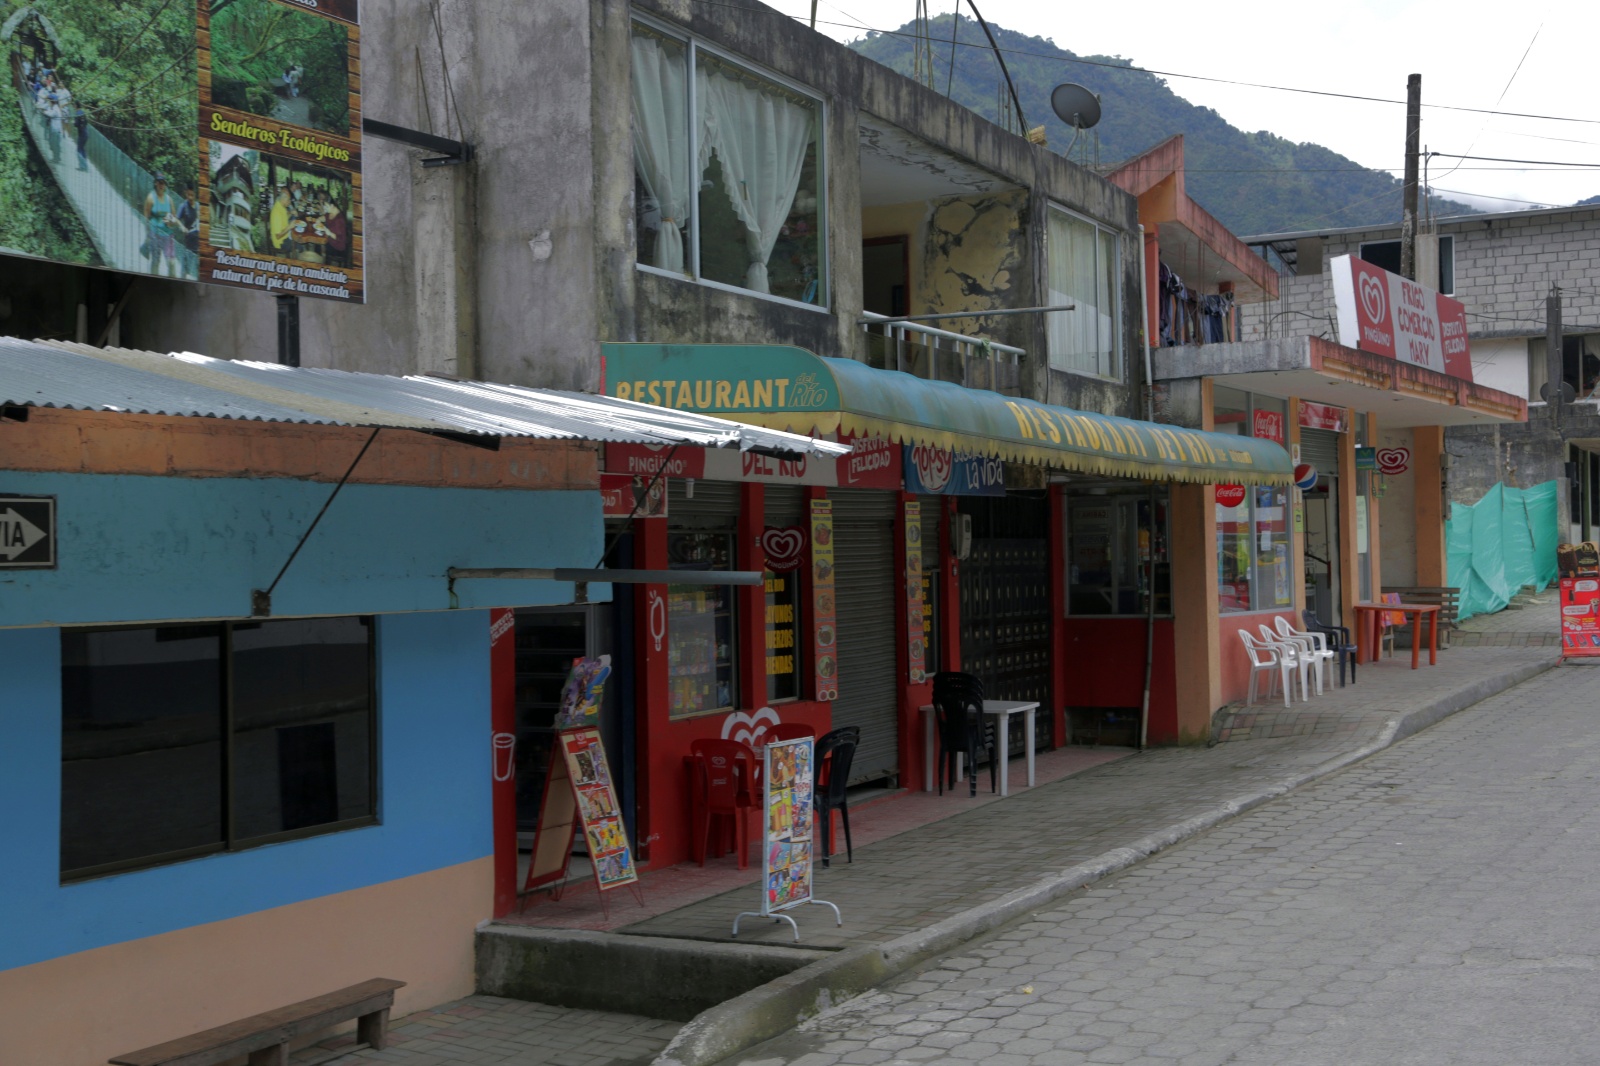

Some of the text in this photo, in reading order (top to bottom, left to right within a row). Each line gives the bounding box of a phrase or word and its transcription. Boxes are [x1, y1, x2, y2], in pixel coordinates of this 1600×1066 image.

[210, 112, 349, 161] Senderos Ecológicos
[215, 250, 348, 284] Restaurant en un ambiente
[212, 269, 349, 299] natural al pie de la cascada
[1401, 281, 1425, 311] FRIGO
[1398, 306, 1435, 341] COMERCIO
[1408, 338, 1430, 366] MARY
[795, 373, 816, 384] del
[616, 378, 789, 409] RESTAURANT
[788, 382, 828, 407] Río
[1005, 401, 1148, 457] RESTAURANT
[1145, 427, 1187, 461] DEL
[742, 452, 773, 477] DEL
[851, 450, 891, 474] FELICIDAD
[1216, 487, 1244, 497] Coca-Cola
[0, 521, 26, 547] IA
